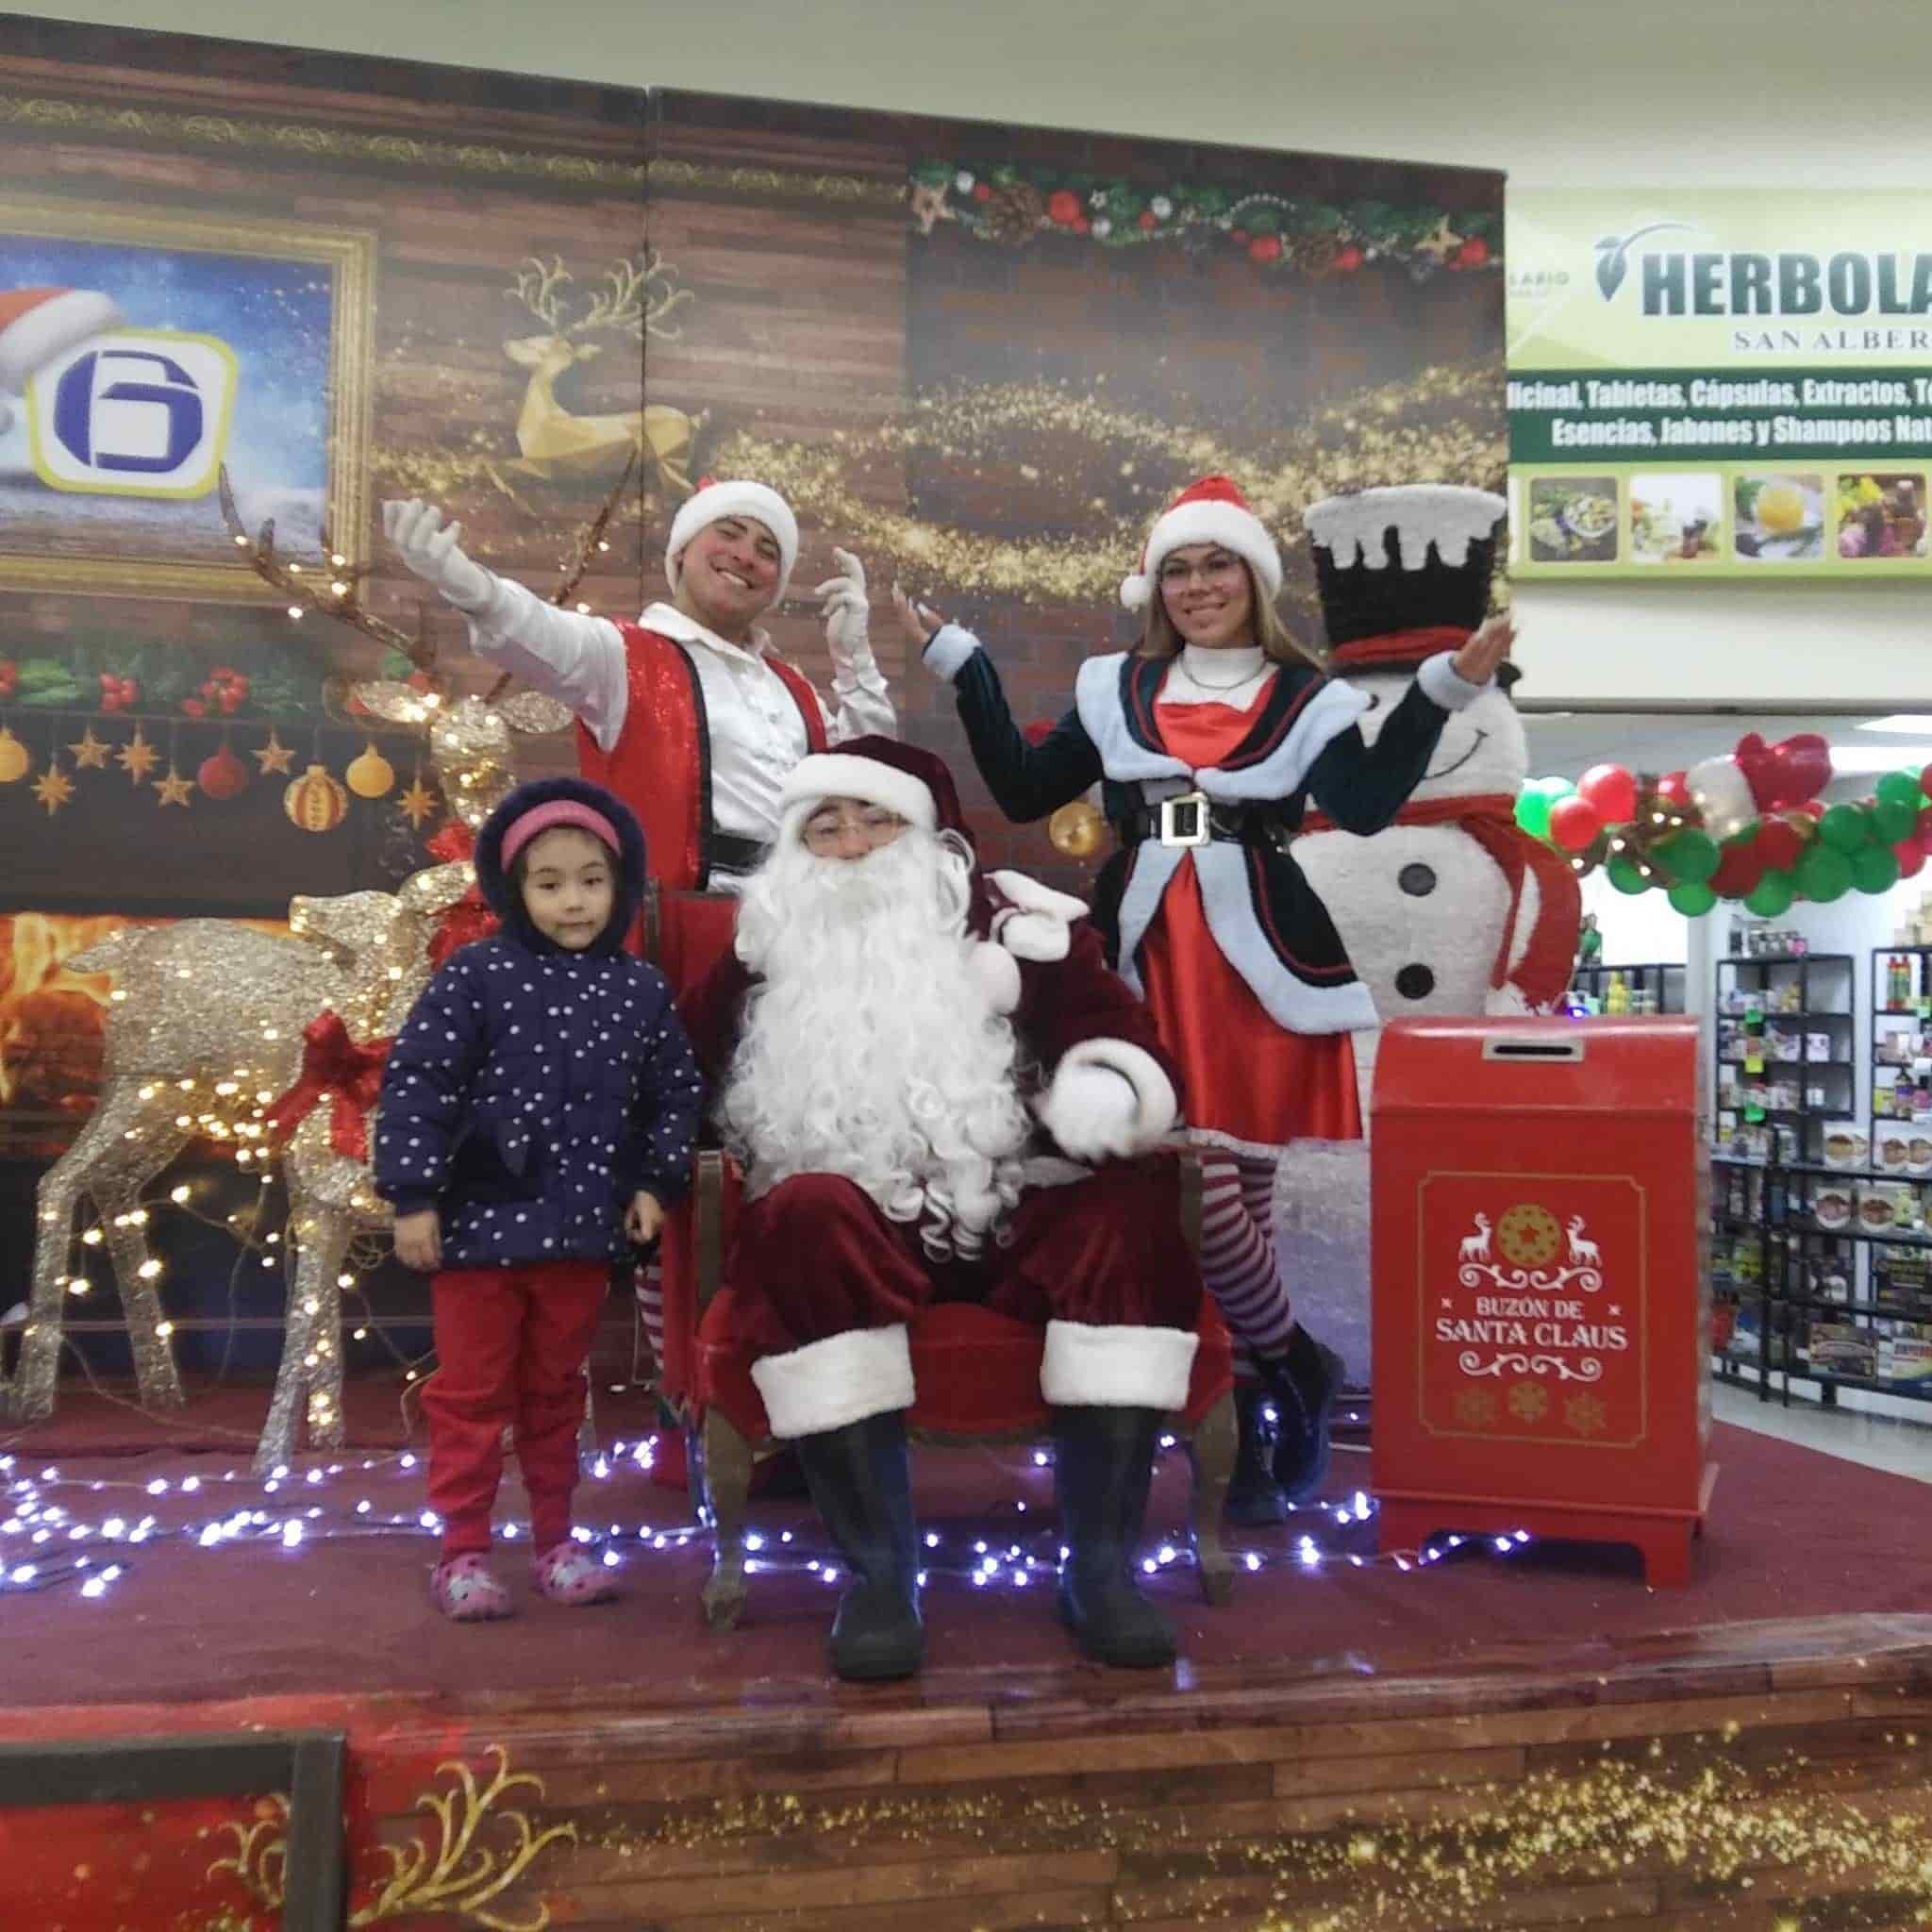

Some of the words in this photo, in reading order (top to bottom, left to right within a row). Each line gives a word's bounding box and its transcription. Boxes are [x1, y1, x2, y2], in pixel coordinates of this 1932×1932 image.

[1735, 330, 1800, 350] SAN
[1812, 329, 1932, 350] ALBER
[1587, 380, 1687, 409] Tabletas,
[1690, 378, 1800, 409] Cápsulas,
[1803, 378, 1912, 408] Extractos,
[1552, 417, 1657, 447] Esencias,
[1660, 417, 1754, 446] Jabones
[1757, 421, 1770, 447] y
[1773, 415, 1891, 446] Shampoos
[1476, 1296, 1550, 1318] BUZÓN
[1554, 1300, 1585, 1321] DE
[1436, 1318, 1527, 1345] SANTA
[1534, 1323, 1628, 1350] CLAUS
